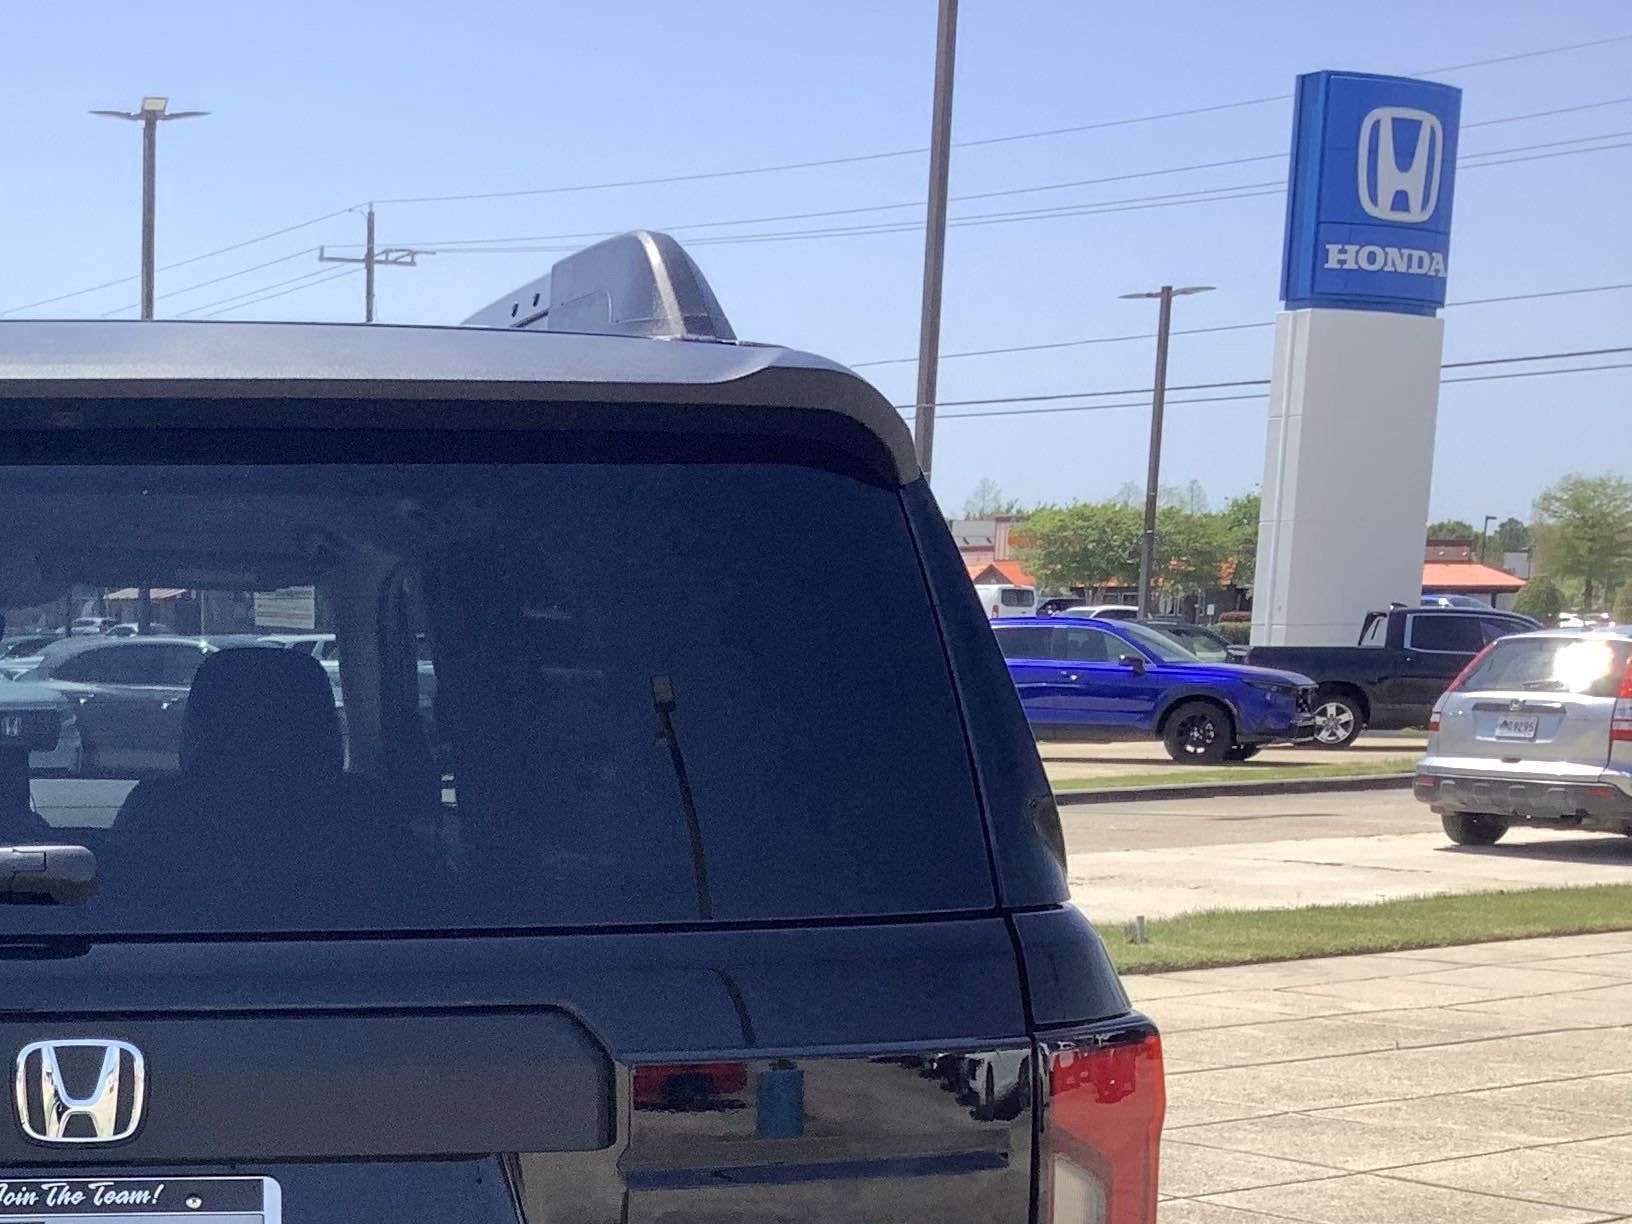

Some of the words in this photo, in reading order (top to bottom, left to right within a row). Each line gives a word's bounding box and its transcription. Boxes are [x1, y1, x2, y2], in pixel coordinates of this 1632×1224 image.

[1324, 243, 1448, 277] HONDA
[42, 1182, 86, 1206] The
[88, 1182, 165, 1206] Team!
